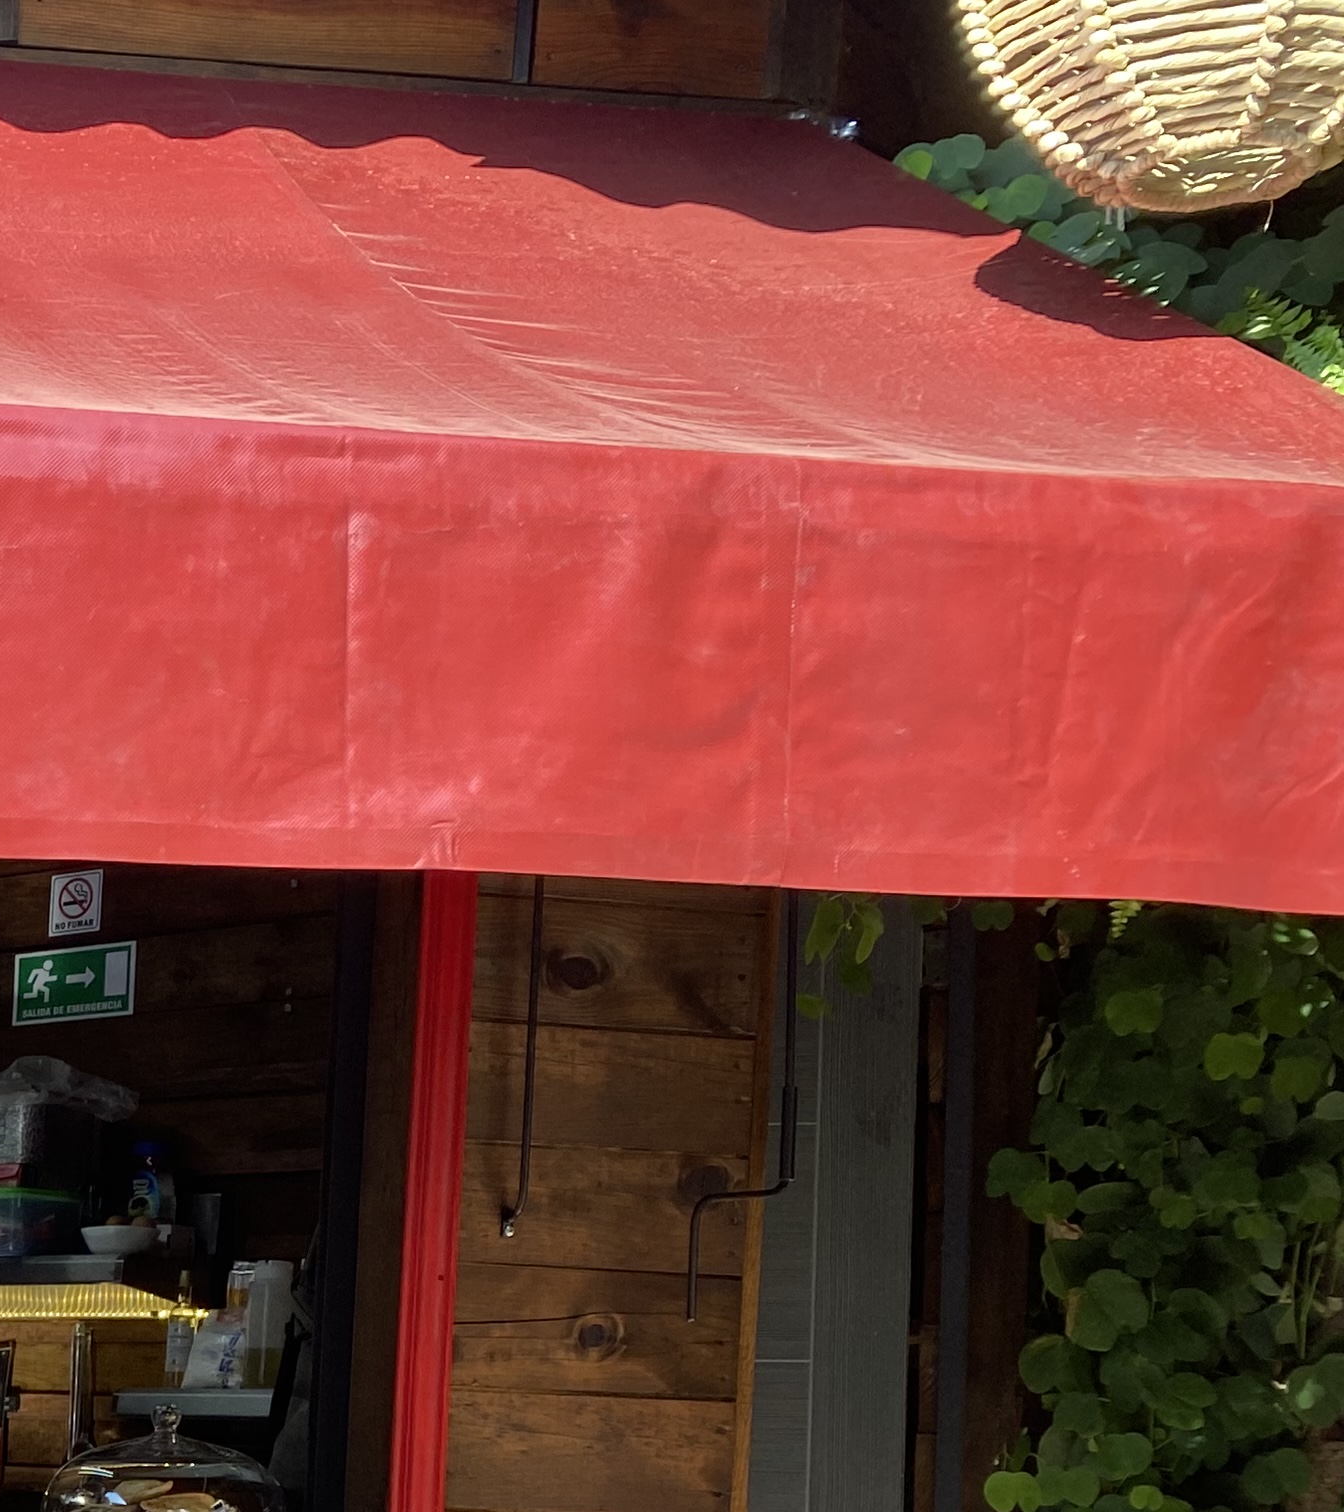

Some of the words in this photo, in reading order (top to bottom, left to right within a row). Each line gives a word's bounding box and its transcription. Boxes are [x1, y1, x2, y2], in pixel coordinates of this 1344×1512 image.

[55, 921, 65, 931] NO
[67, 919, 94, 929] FUMAR
[23, 1007, 51, 1018] SALIDA
[52, 1004, 64, 1015] DE
[67, 1000, 122, 1013] EMERGENCIA
